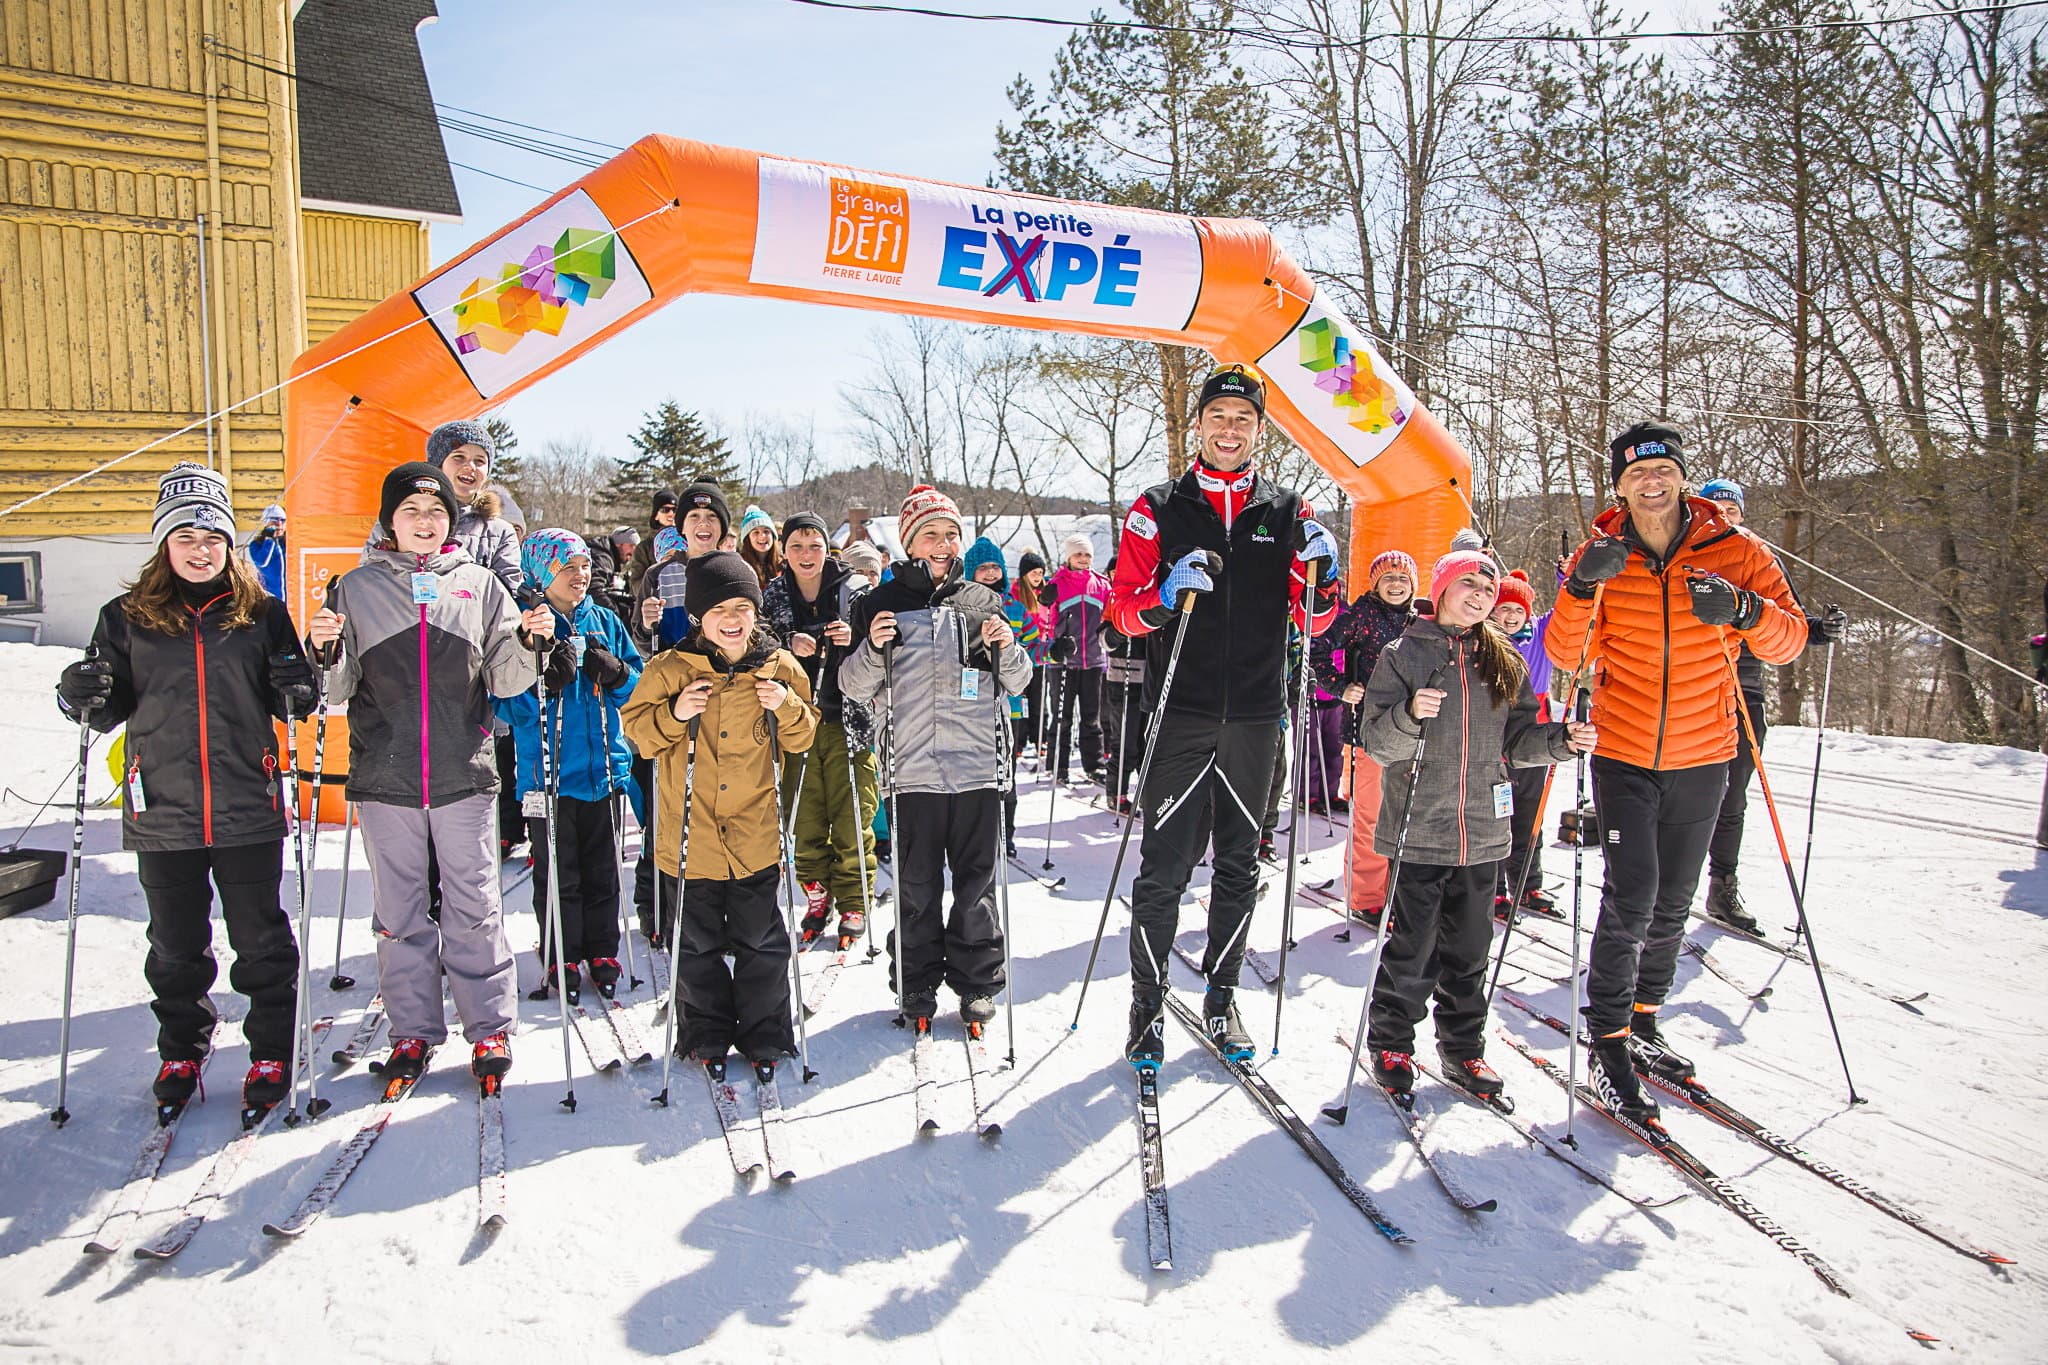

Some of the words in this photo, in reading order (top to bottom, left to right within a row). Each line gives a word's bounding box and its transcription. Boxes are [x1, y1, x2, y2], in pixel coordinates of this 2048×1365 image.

[837, 181, 851, 193] le
[836, 193, 904, 218] grand
[971, 204, 1004, 225] La
[1013, 210, 1094, 238] petite
[822, 266, 862, 280] PIERRE
[866, 271, 903, 286] LAVOIE
[937, 226, 1142, 307] EXPÉ
[1221, 383, 1245, 393] Sepaq
[1251, 533, 1275, 544] Sepaq
[312, 562, 329, 582] le
[1648, 1071, 1692, 1102] ROSSIGNOL
[1614, 1111, 1653, 1145] ROSSIGNOL
